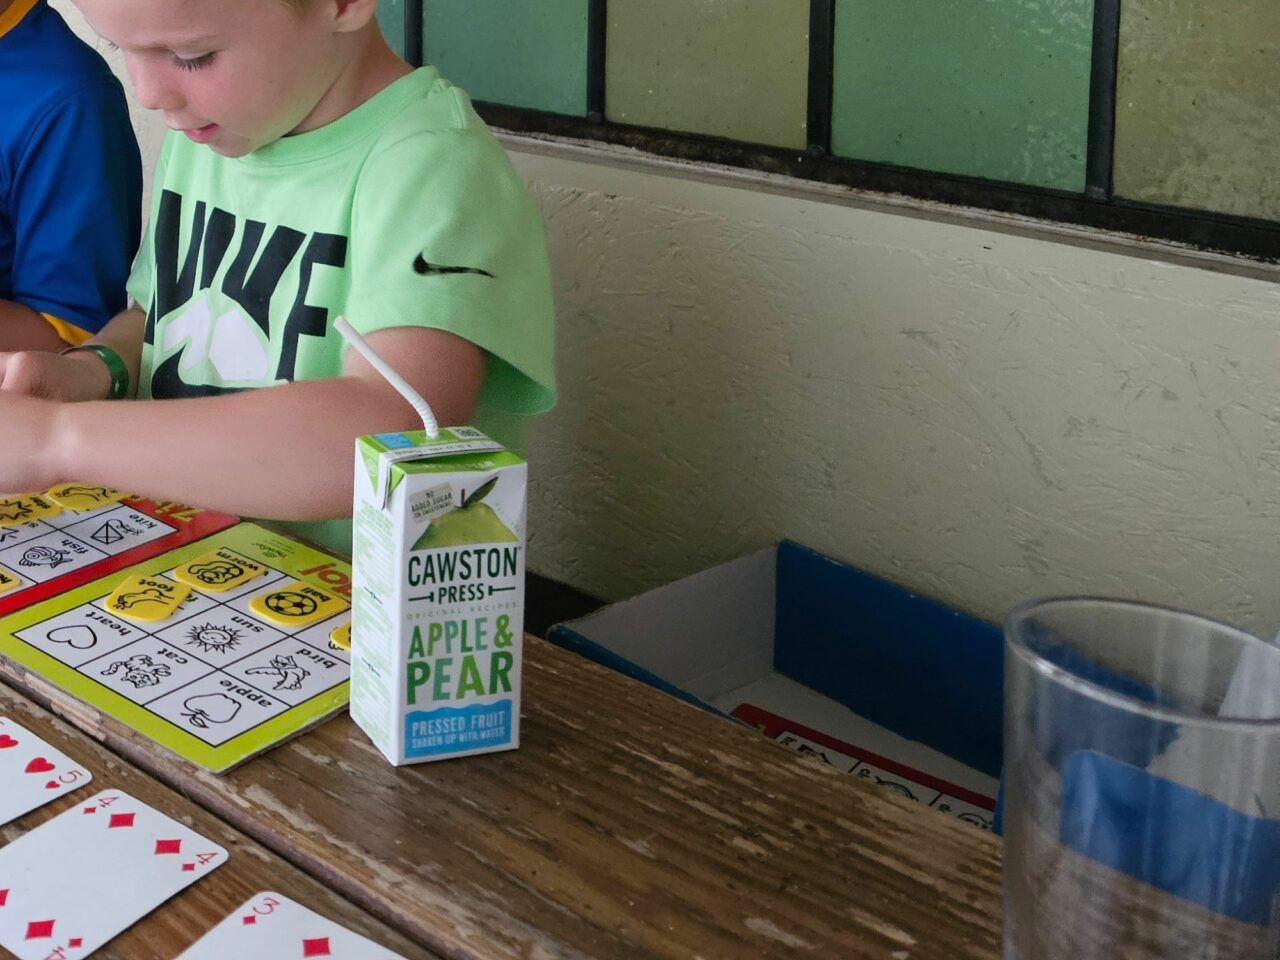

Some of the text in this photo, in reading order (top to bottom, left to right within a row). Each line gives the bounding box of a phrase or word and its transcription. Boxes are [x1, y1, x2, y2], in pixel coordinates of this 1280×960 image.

[145, 189, 348, 385] NIKE
[29, 495, 54, 511] star
[411, 493, 452, 512] ADDED SUGAR
[129, 512, 159, 530] kite
[61, 538, 89, 555] fish
[216, 550, 261, 571] worm
[408, 546, 517, 587] CAWSTON
[137, 577, 175, 593] foot
[438, 583, 484, 605] PRESS
[299, 586, 330, 604] ball
[407, 602, 518, 621] ORIGINAL RECIPES
[84, 610, 132, 637] heart
[230, 615, 265, 634] sun
[408, 617, 488, 660] APPLE
[493, 613, 513, 649] &
[157, 647, 190, 666] cat
[298, 647, 338, 671] bird
[406, 651, 513, 706] PEAR
[219, 678, 274, 709] apple
[412, 710, 505, 737] PRESSED FRUIT
[412, 734, 443, 749] SHAKEN
[458, 730, 478, 744] WITH
[480, 726, 505, 742] WATER
[59, 769, 84, 784] 5
[97, 796, 120, 808] 4
[195, 851, 219, 865] 4
[252, 897, 279, 917] 3
